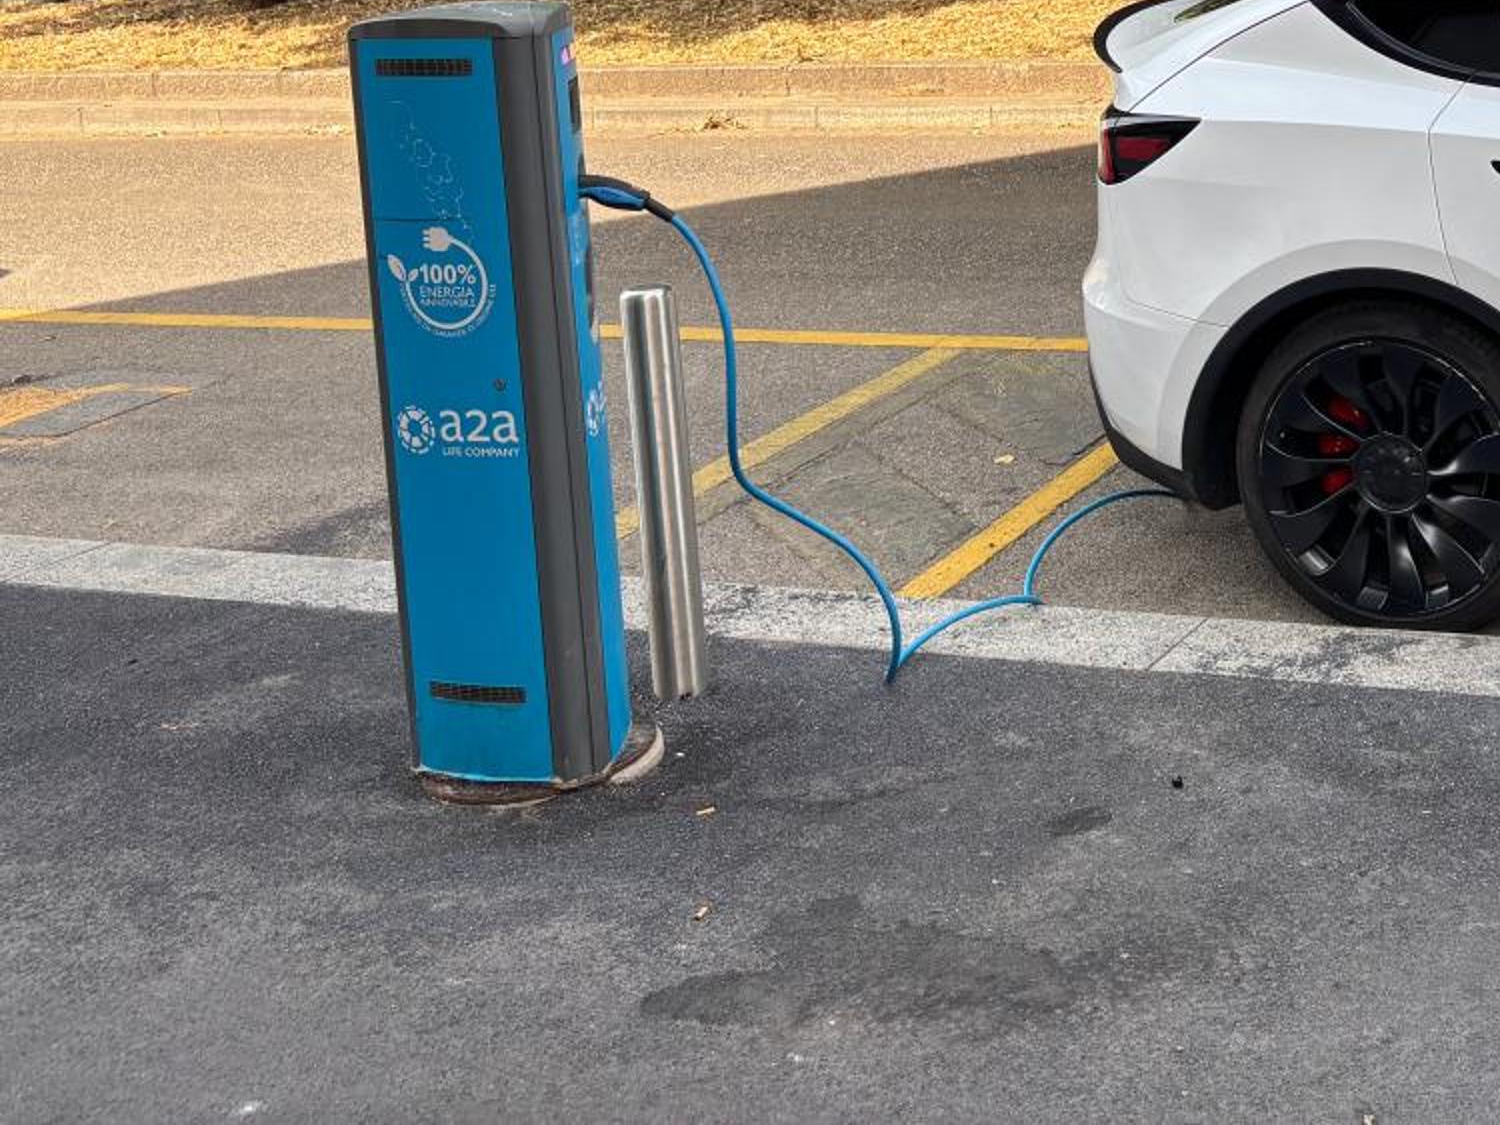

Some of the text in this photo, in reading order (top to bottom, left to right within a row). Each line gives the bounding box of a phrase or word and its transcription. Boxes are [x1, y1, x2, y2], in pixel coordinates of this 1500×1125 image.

[420, 264, 476, 284] 100%
[419, 285, 475, 298] ENERGIA
[440, 409, 519, 443] a2a
[465, 446, 520, 458] COMPANY
